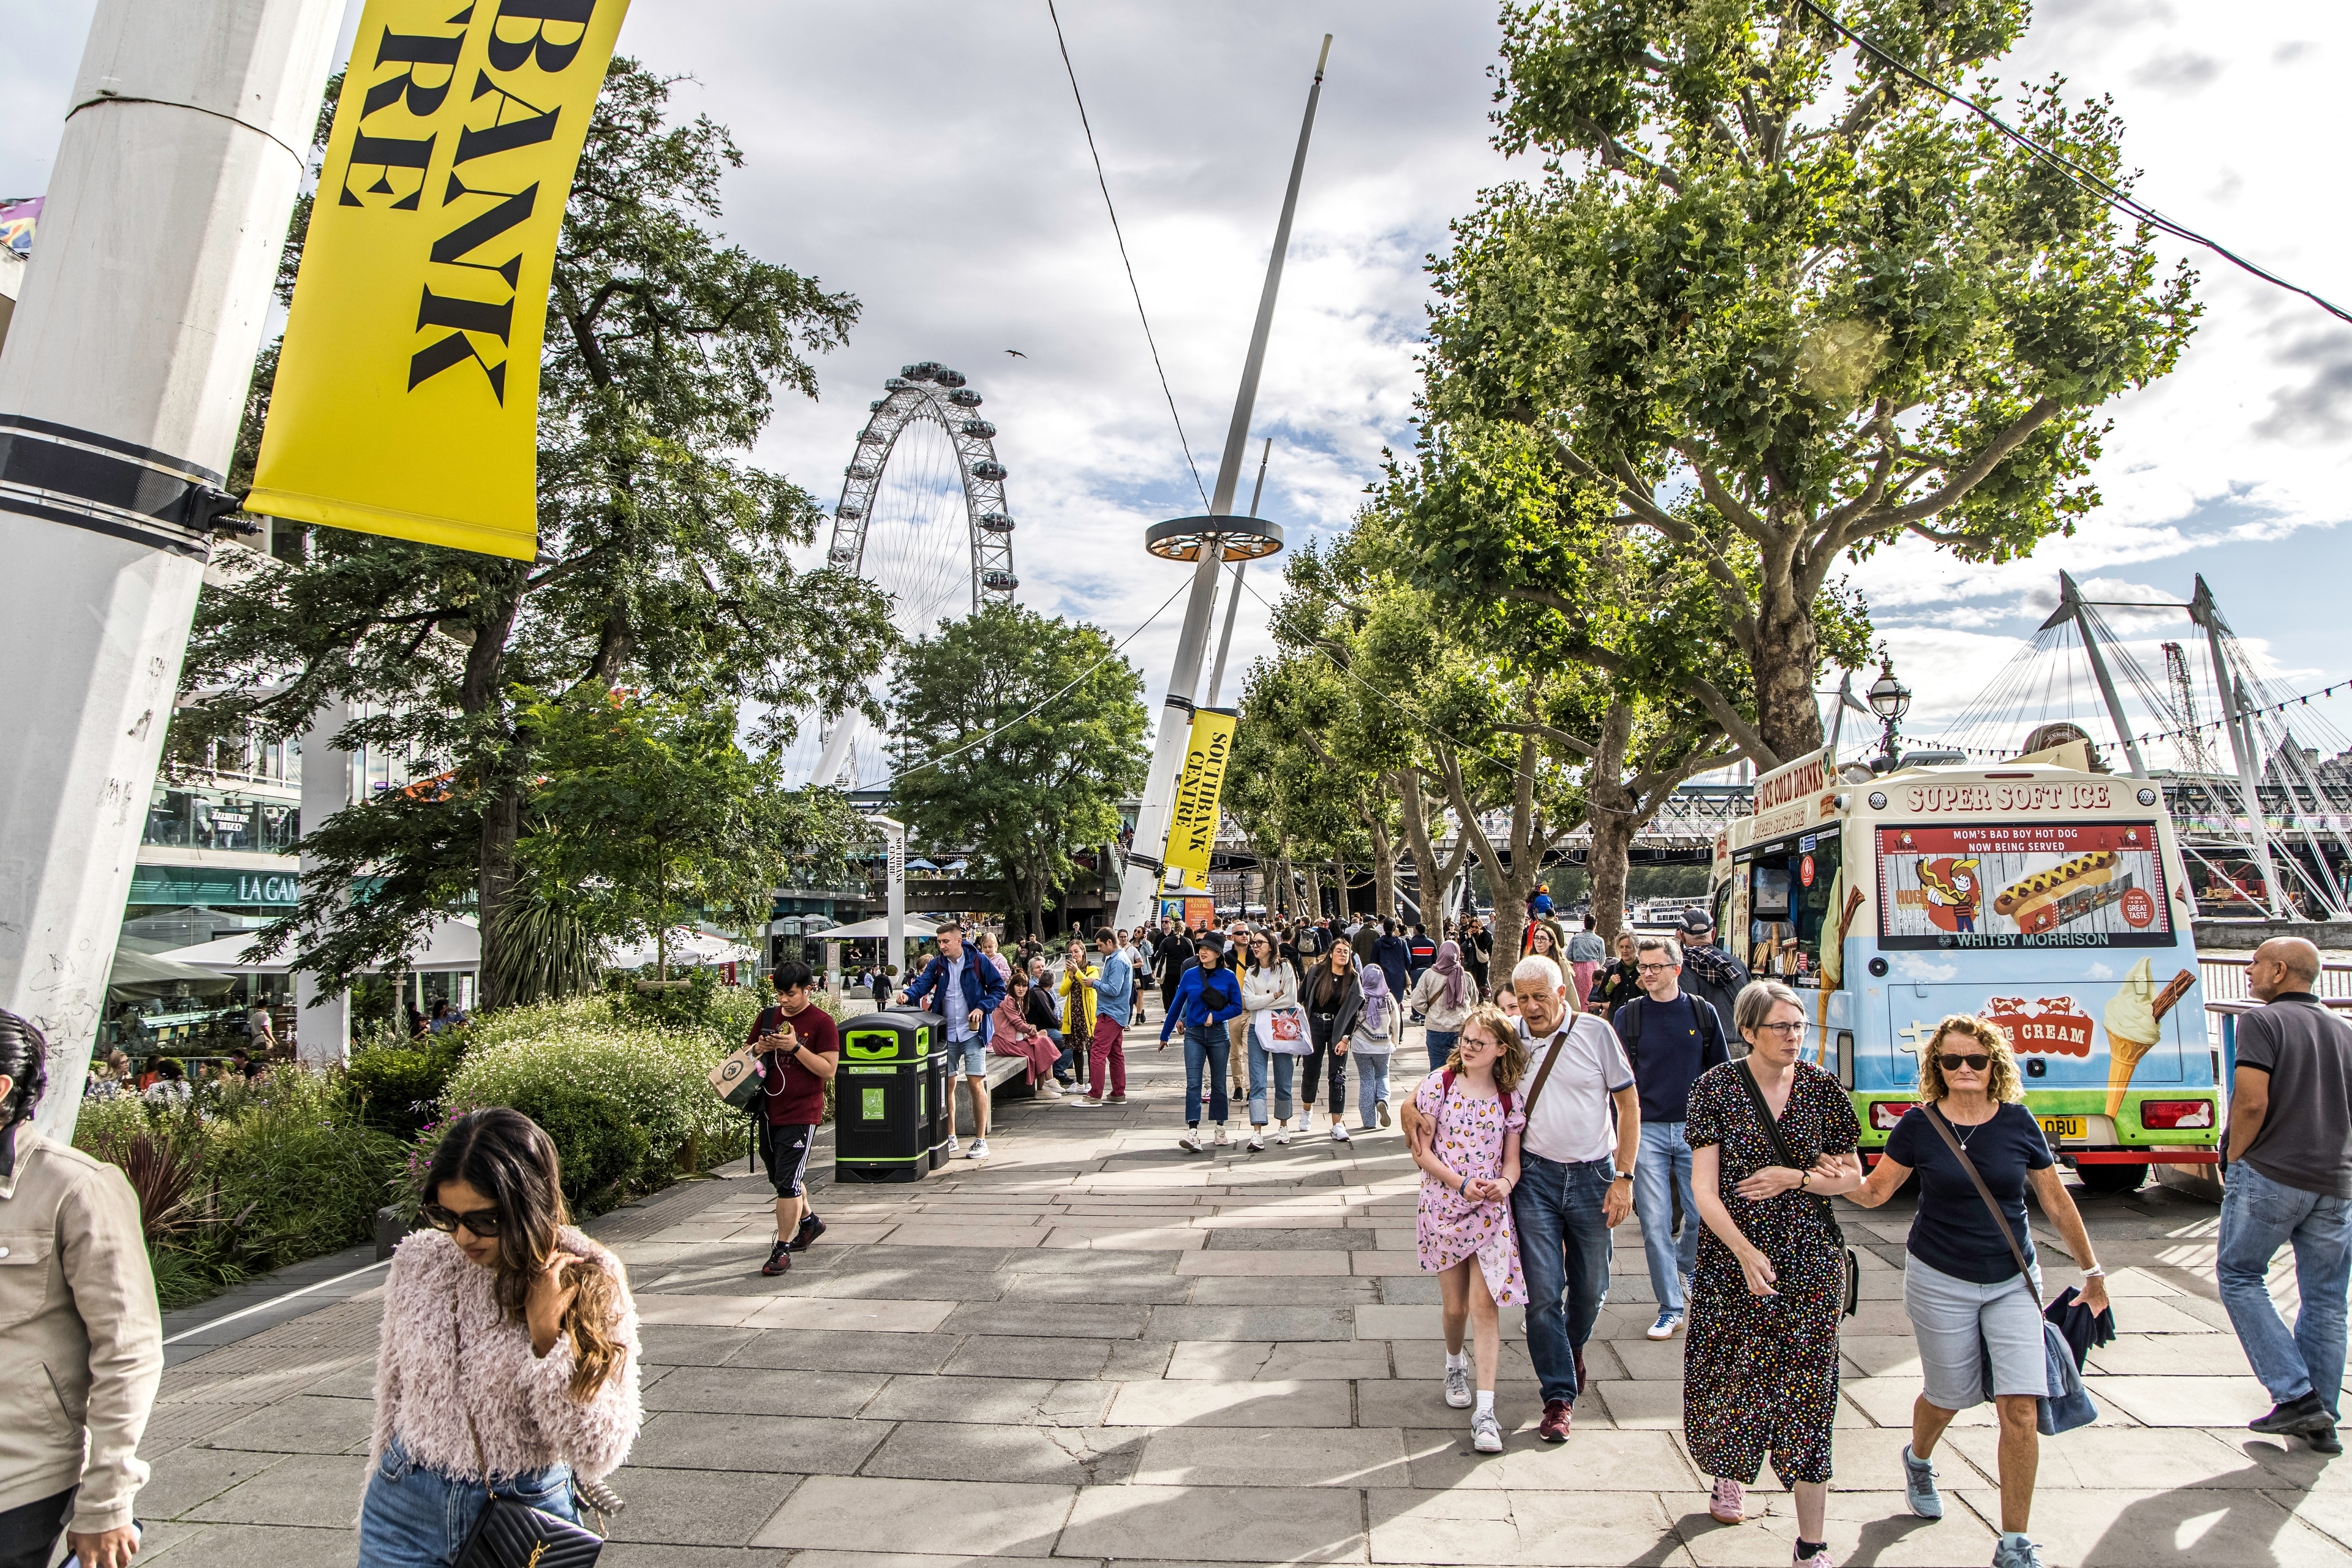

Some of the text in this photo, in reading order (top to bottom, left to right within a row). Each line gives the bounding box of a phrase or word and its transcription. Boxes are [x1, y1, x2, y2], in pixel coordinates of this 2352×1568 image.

[1175, 751, 1205, 828] CENTRE
[1189, 732, 1227, 854] SOUTHBANK
[1763, 780, 1773, 810] ICE
[1775, 772, 1792, 805] COLD
[1794, 759, 1823, 799] DRINKS
[1907, 782, 2111, 813] SUPER SOFT ICE
[1752, 807, 1805, 840] SUPER SOFT ICE
[1953, 829, 2078, 840] MOM'S BAD BOY HOT DOG
[1969, 842, 2065, 852] NOW BEING SERVED
[240, 876, 261, 900] LA
[1896, 889, 1928, 905] HUGE
[1897, 909, 1930, 919] BAD BOY
[1899, 919, 1931, 930] HOT DOG
[1956, 933, 2018, 947] WHITBY
[2022, 933, 2109, 946] MORRISON
[2022, 1023, 2086, 1044] CREAM
[2045, 1120, 2077, 1135] OBU
